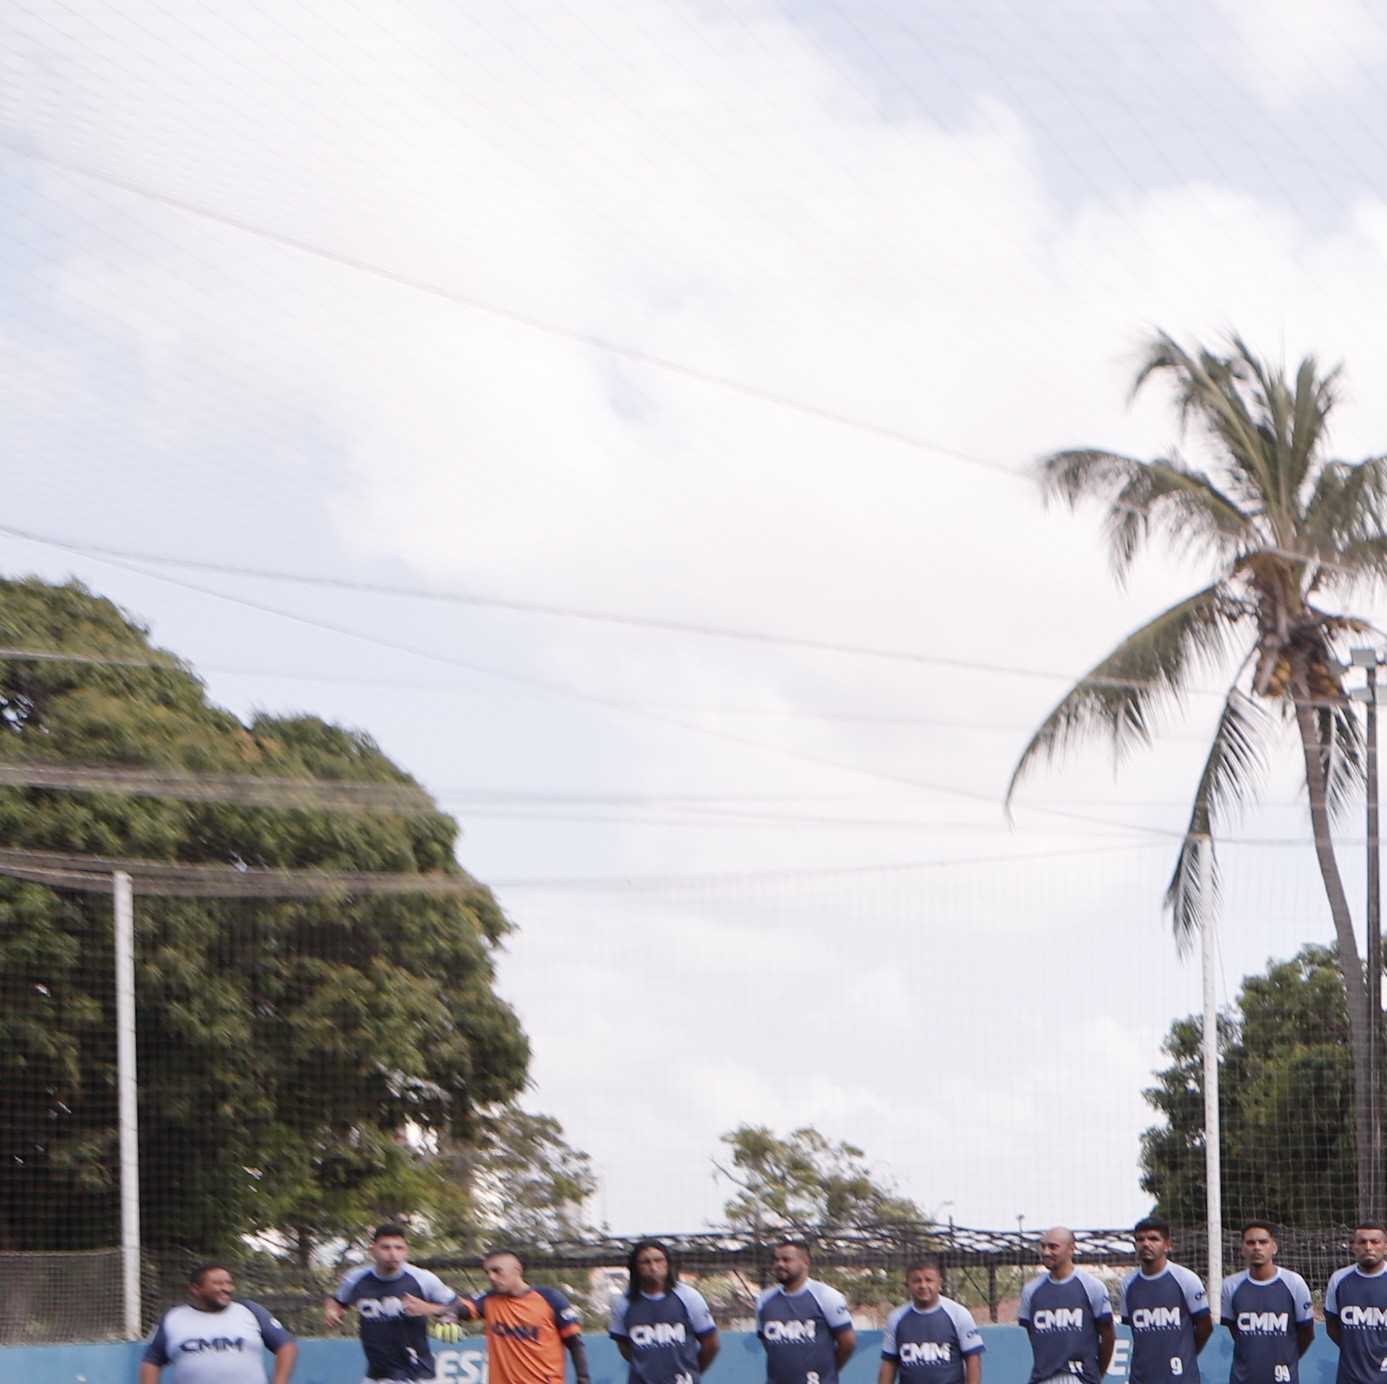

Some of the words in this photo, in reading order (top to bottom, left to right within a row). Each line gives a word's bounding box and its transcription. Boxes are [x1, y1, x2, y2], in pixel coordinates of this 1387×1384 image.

[1033, 1308, 1083, 1328] CMM
[1132, 1307, 1181, 1328] CMM
[1237, 1312, 1288, 1332] CMM
[629, 1323, 686, 1345] CMM
[763, 1320, 816, 1342] CMM
[900, 1343, 950, 1363] CMM
[1170, 1357, 1182, 1375] 9
[1274, 1365, 1291, 1382] 99
